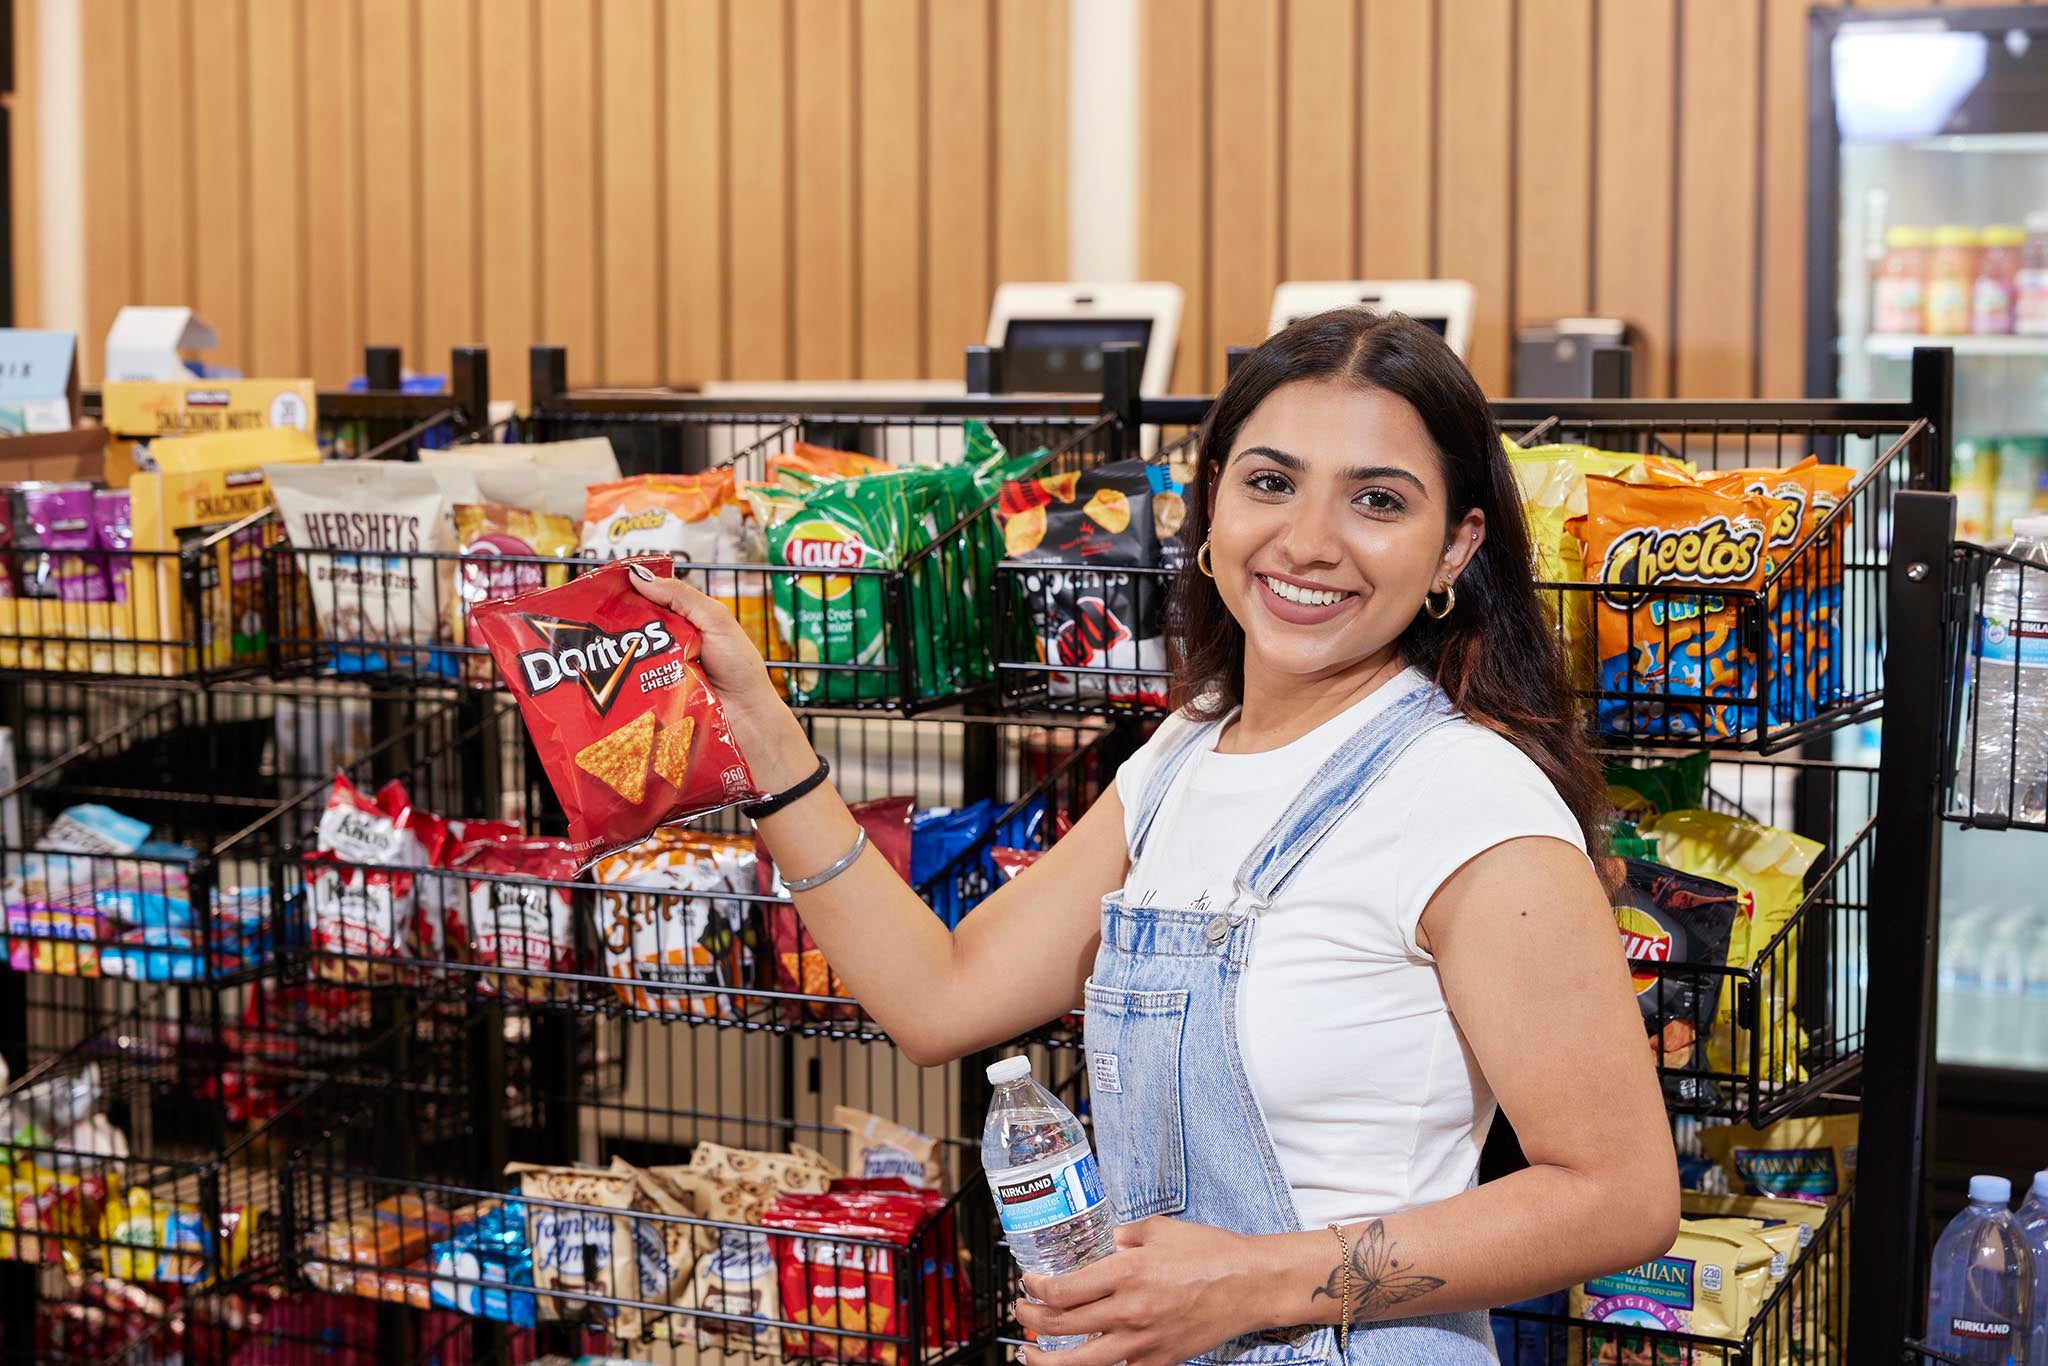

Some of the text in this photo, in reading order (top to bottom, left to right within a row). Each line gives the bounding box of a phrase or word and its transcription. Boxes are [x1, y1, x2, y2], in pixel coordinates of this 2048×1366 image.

[304, 513, 419, 553] HERSHEY'S
[1607, 523, 1756, 597] Cheetos
[522, 621, 671, 692] Doritos
[640, 660, 681, 683] NACHO
[641, 670, 685, 693] CHEESE
[724, 767, 745, 785] 260
[1000, 1178, 1052, 1199] KIRKLAND
[1704, 1267, 1720, 1279] 230
[1597, 1298, 1675, 1331] ORIGINAL
[1953, 1319, 2010, 1335] KIRKLAND
